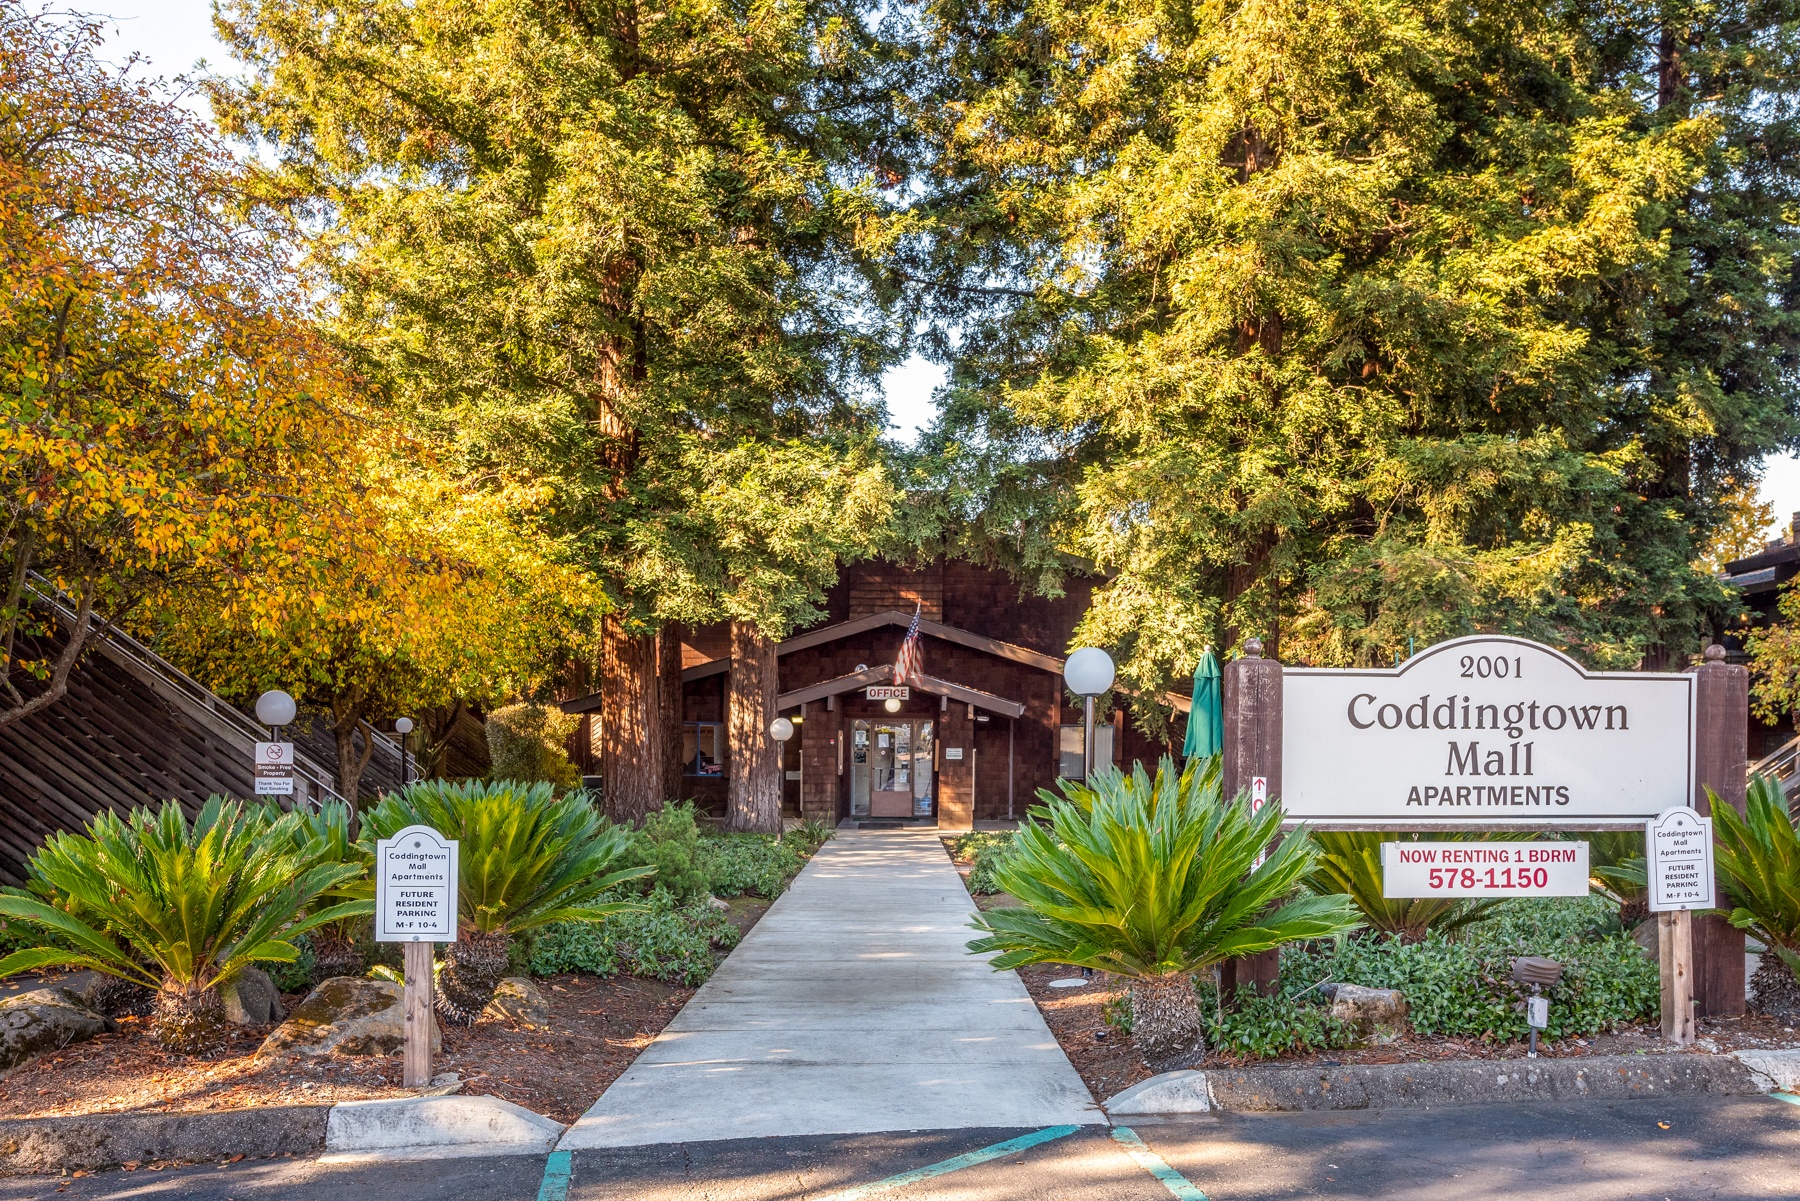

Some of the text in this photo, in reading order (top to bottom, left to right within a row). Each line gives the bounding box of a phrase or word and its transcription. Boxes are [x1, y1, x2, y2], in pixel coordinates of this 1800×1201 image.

[1460, 656, 1522, 679] 2001
[869, 688, 907, 698] OFFICE
[1347, 693, 1629, 739] Coddingtown
[1445, 741, 1534, 776] Mall
[1405, 786, 1570, 807] APARTMENTS
[1657, 830, 1703, 839] Coddingtown
[389, 852, 446, 861] Coddingtown
[1400, 850, 1576, 863] NOW RENTING 1 BDRM
[1660, 848, 1702, 857] Apartments
[391, 873, 444, 881] Apartments
[1428, 868, 1548, 889] 578-1150
